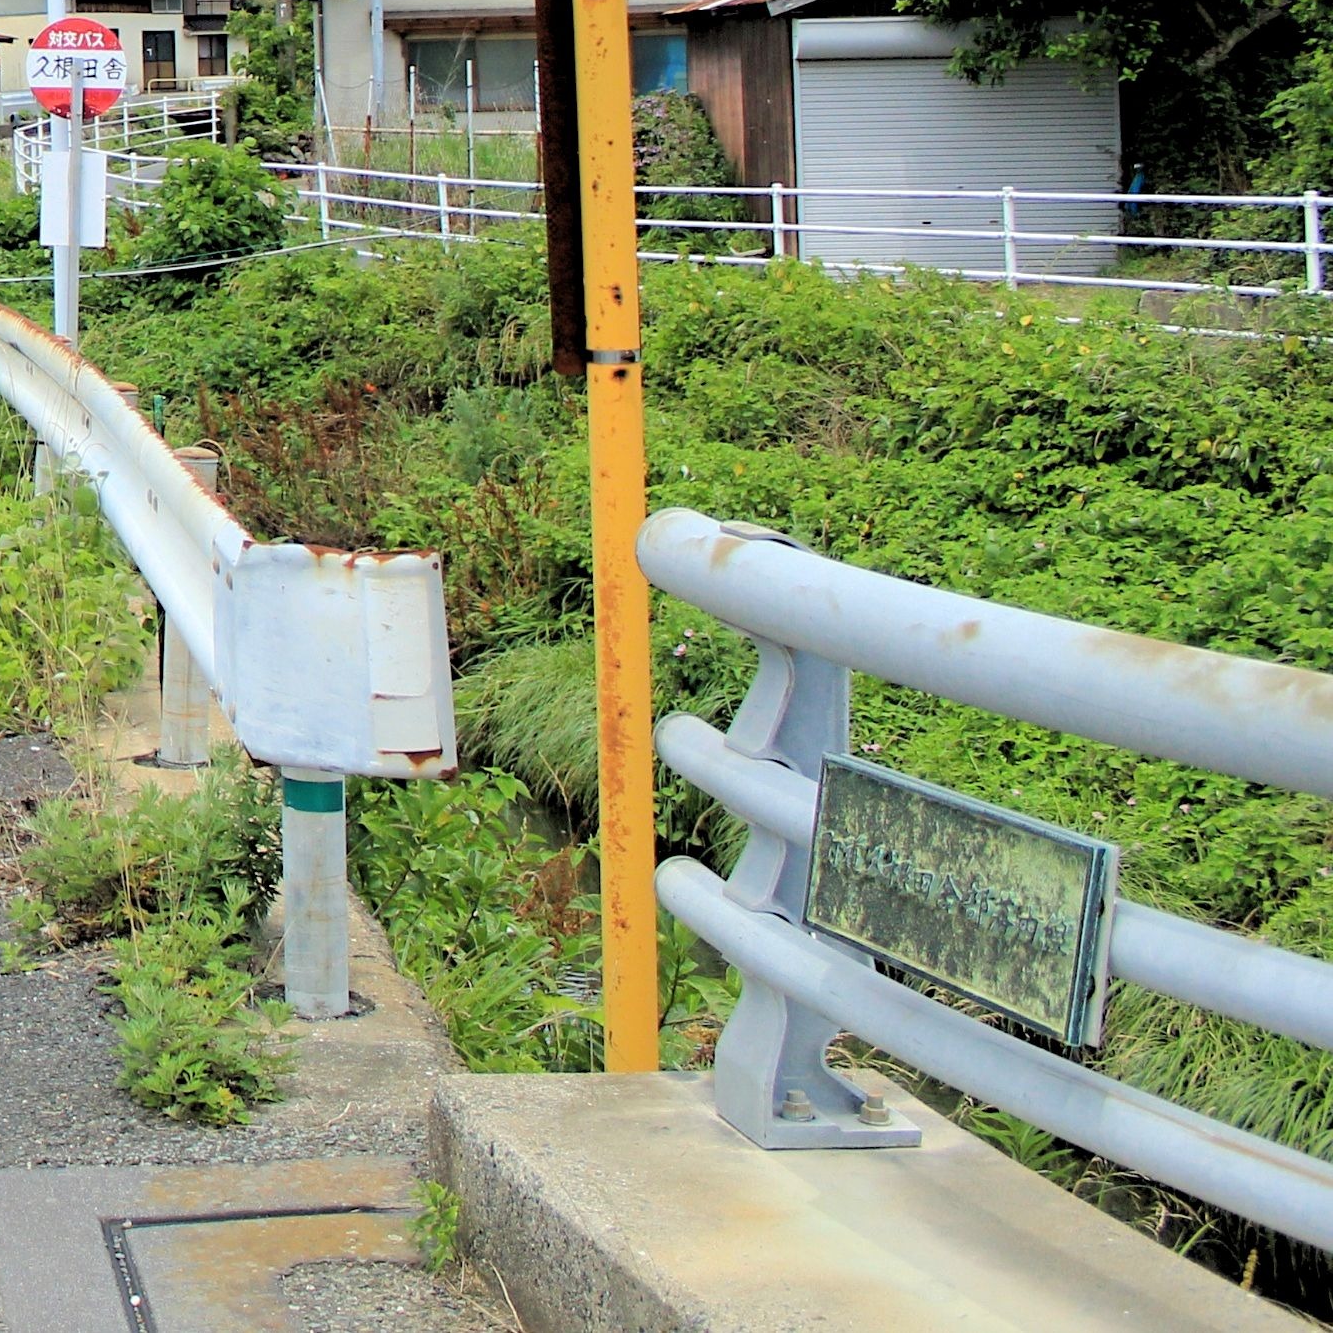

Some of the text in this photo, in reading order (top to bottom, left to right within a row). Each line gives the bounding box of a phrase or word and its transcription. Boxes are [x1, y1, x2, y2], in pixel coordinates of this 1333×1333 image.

[48, 30, 105, 47] 対交バス
[32, 55, 126, 80] 久根田舎
